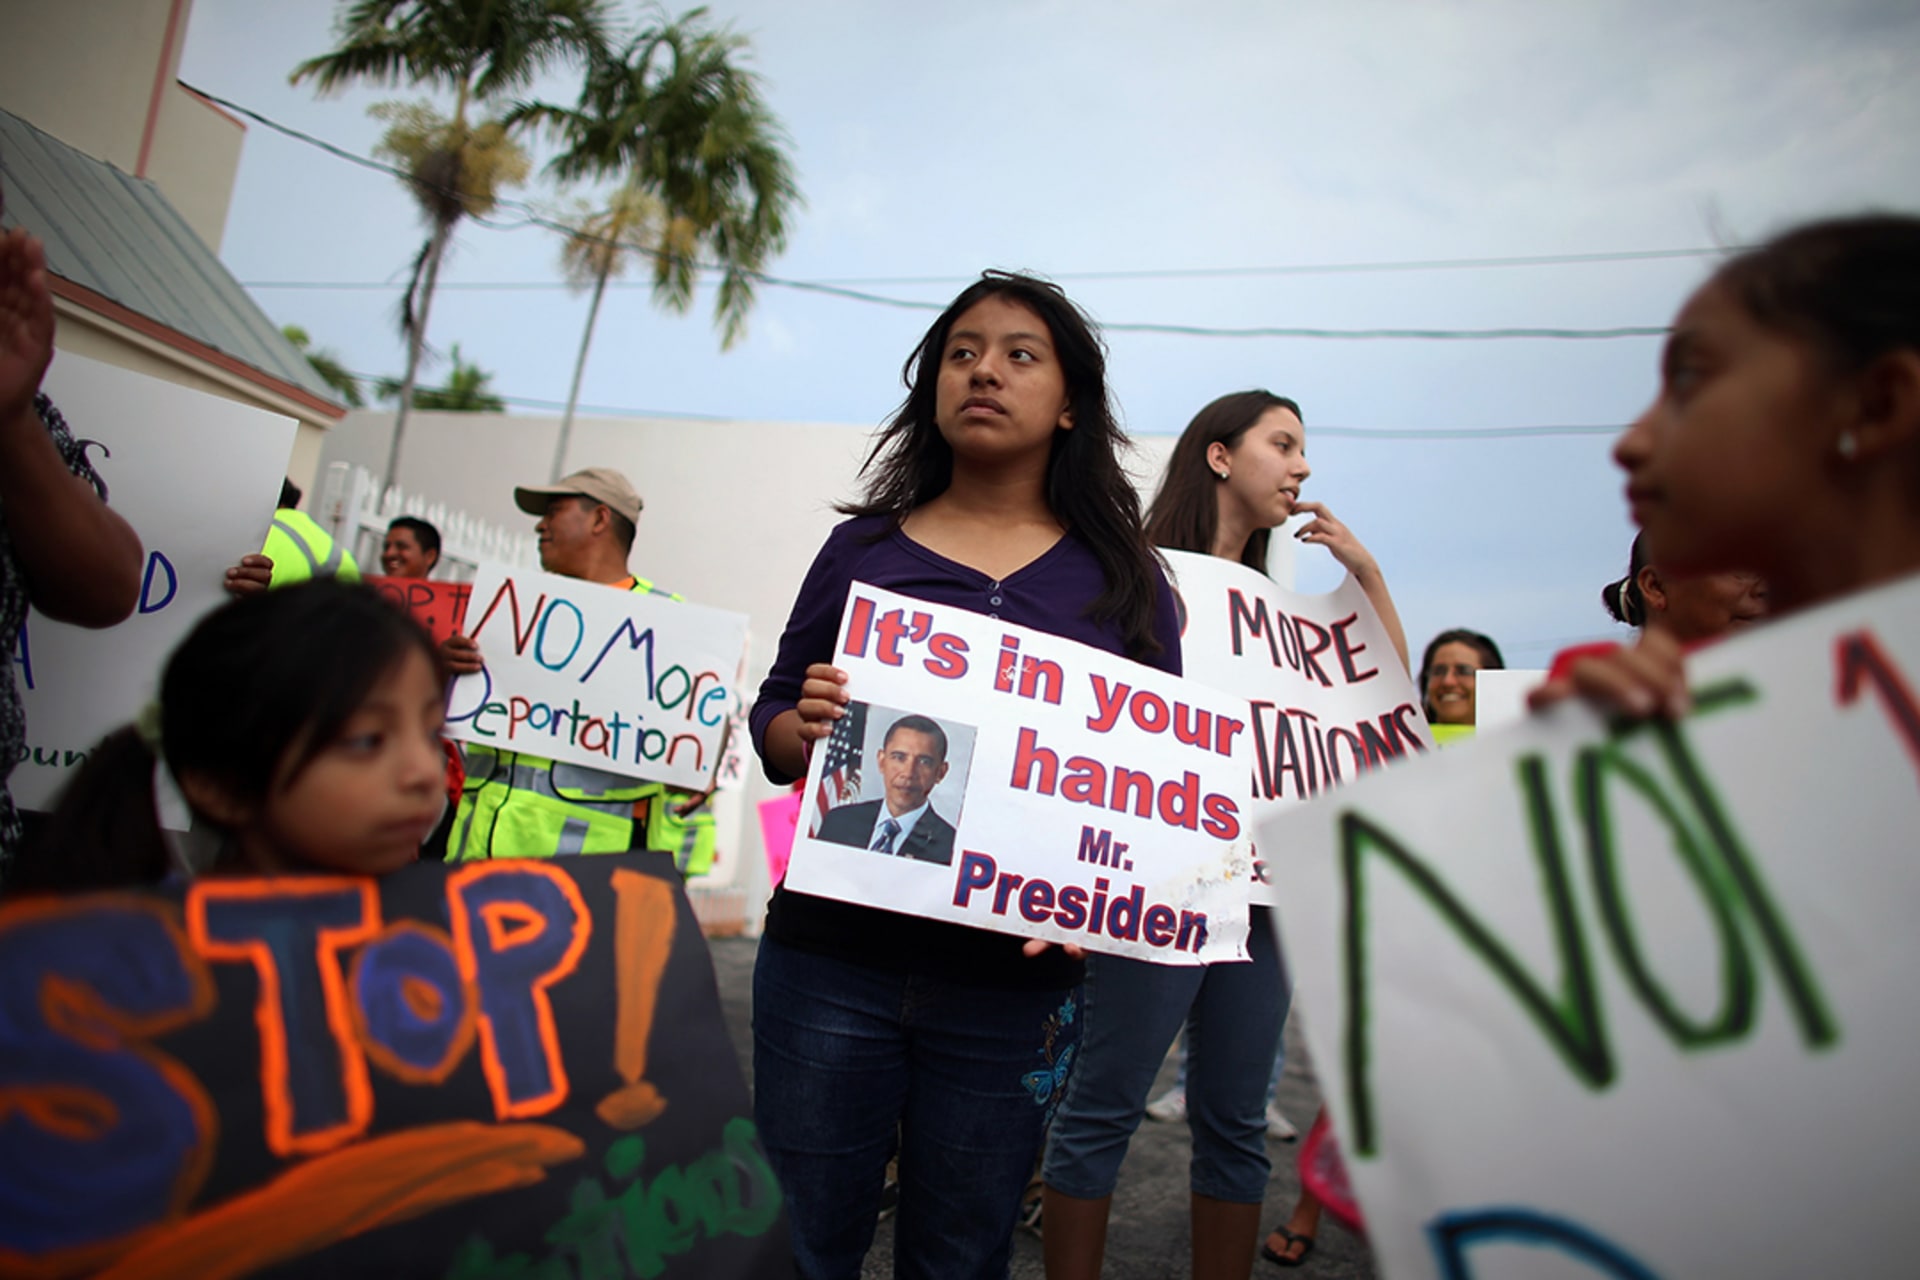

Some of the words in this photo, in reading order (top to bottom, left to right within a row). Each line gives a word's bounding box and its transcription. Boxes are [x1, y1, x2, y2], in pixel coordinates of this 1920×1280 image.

[469, 578, 584, 671] NO
[579, 617, 726, 726] More
[842, 595, 970, 680] It's
[993, 634, 1064, 705] in
[1086, 672, 1245, 757] your
[1227, 588, 1379, 687] MORE
[1009, 726, 1242, 841] hands
[1251, 699, 1430, 801] TATIONS
[1077, 826, 1135, 872] Mr.
